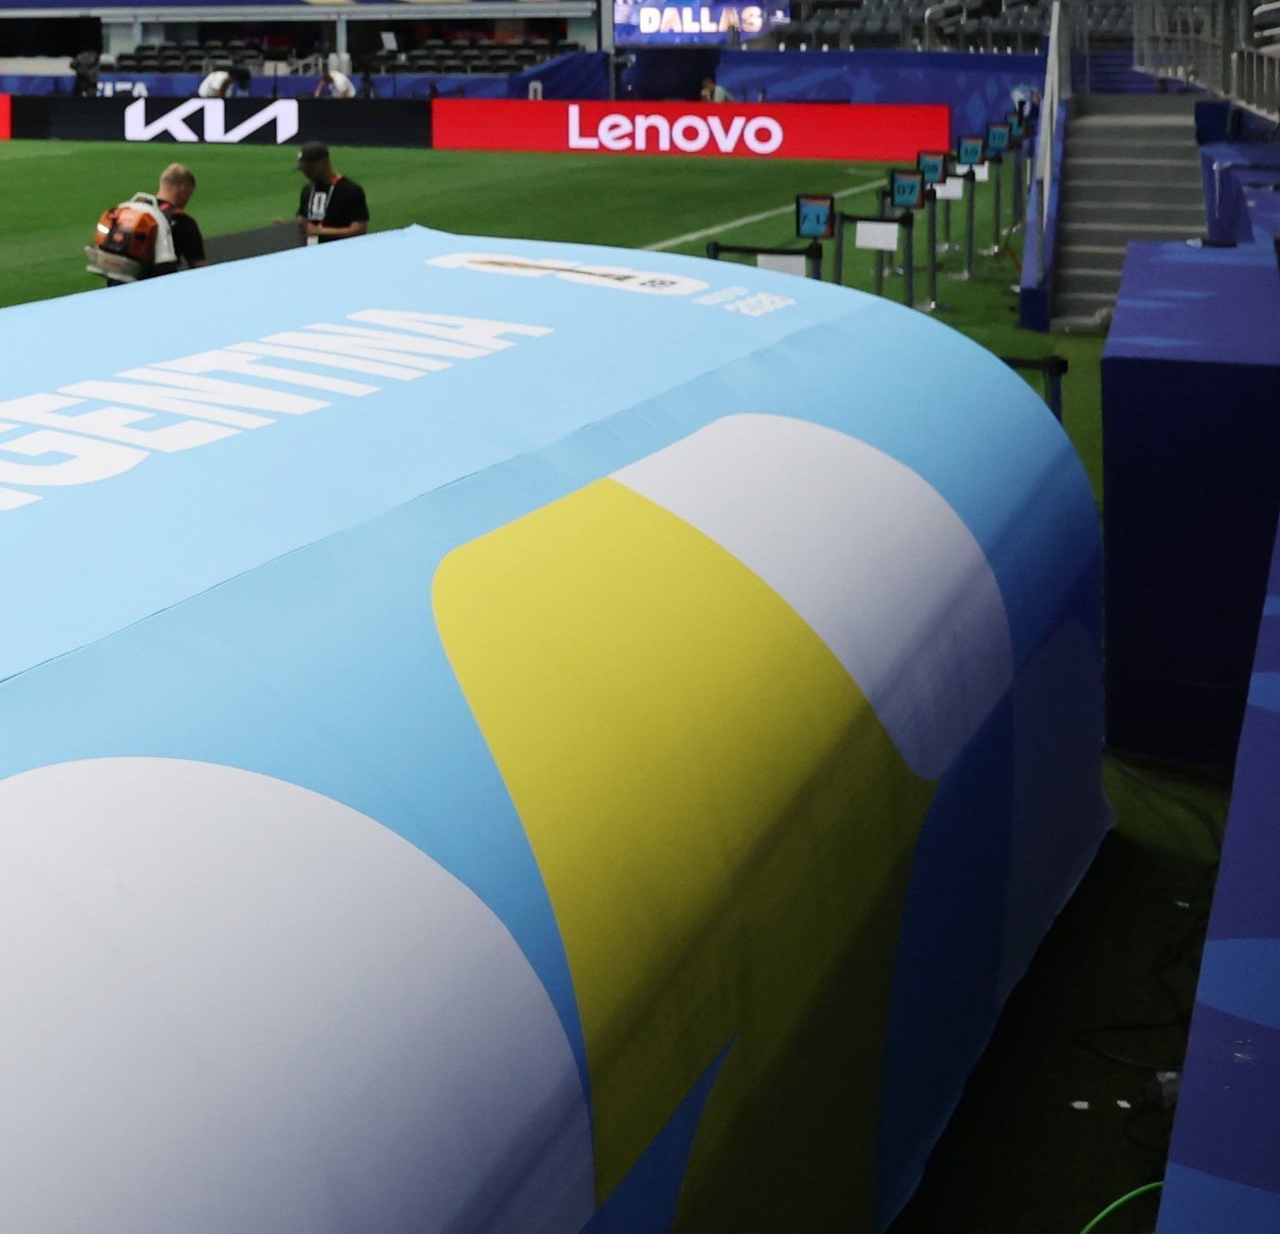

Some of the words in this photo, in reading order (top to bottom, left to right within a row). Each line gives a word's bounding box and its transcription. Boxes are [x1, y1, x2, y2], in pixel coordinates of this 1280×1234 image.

[640, 6, 762, 34] DALLAS
[124, 98, 299, 144] KIA
[568, 104, 783, 154] Lenovo
